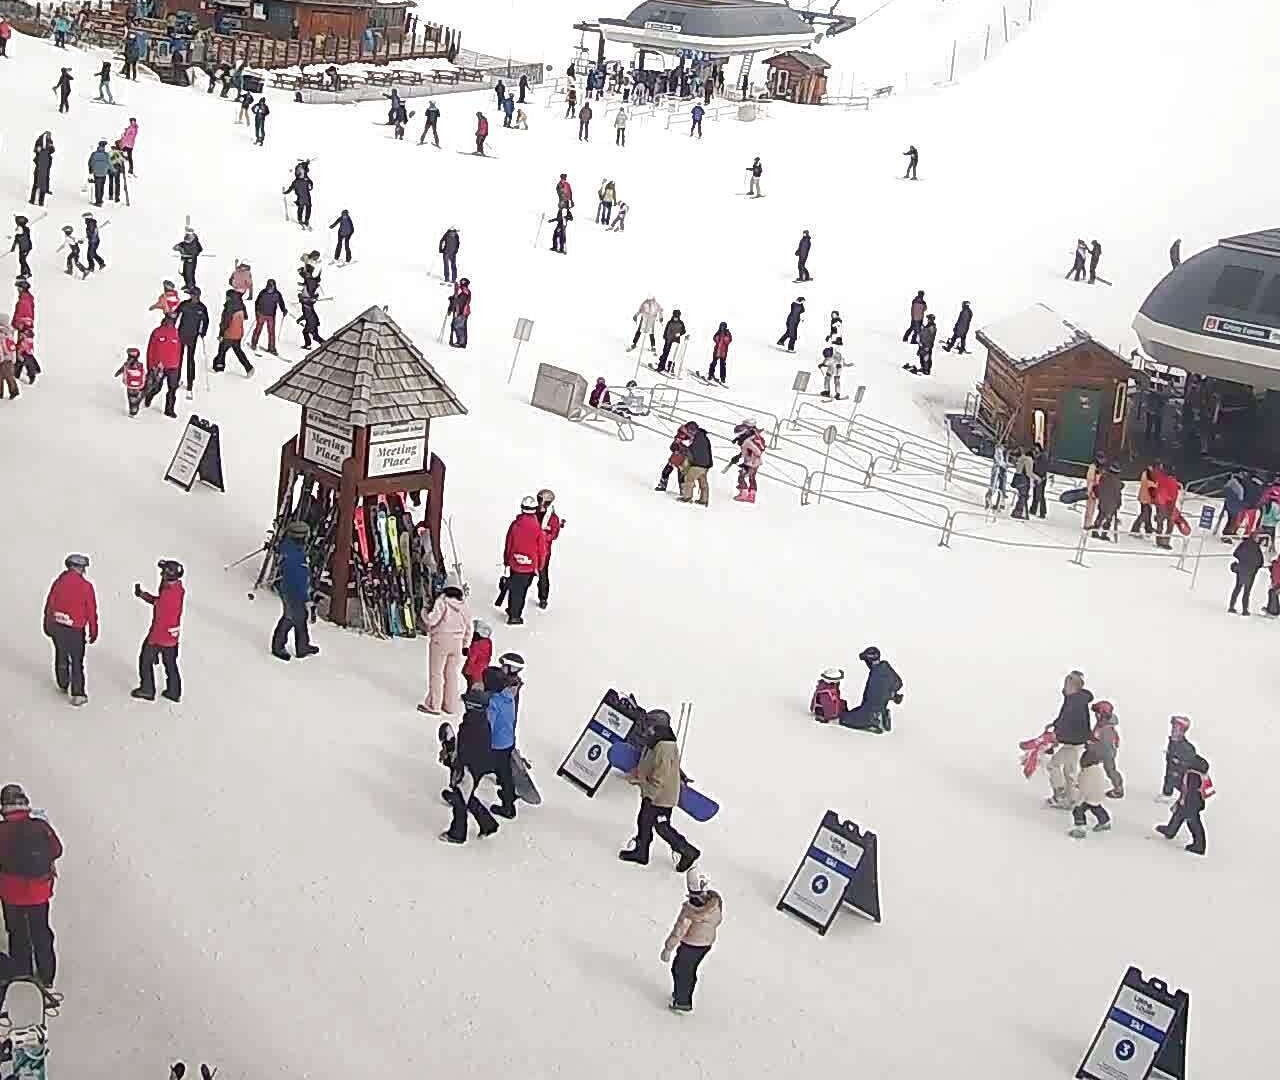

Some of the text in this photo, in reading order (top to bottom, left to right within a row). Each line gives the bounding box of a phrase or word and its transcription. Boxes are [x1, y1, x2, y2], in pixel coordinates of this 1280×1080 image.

[312, 431, 346, 455] Meeting
[377, 443, 417, 459] Meeting
[315, 446, 340, 463] Place
[382, 456, 411, 468] Place
[1119, 1042, 1131, 1056] 3
